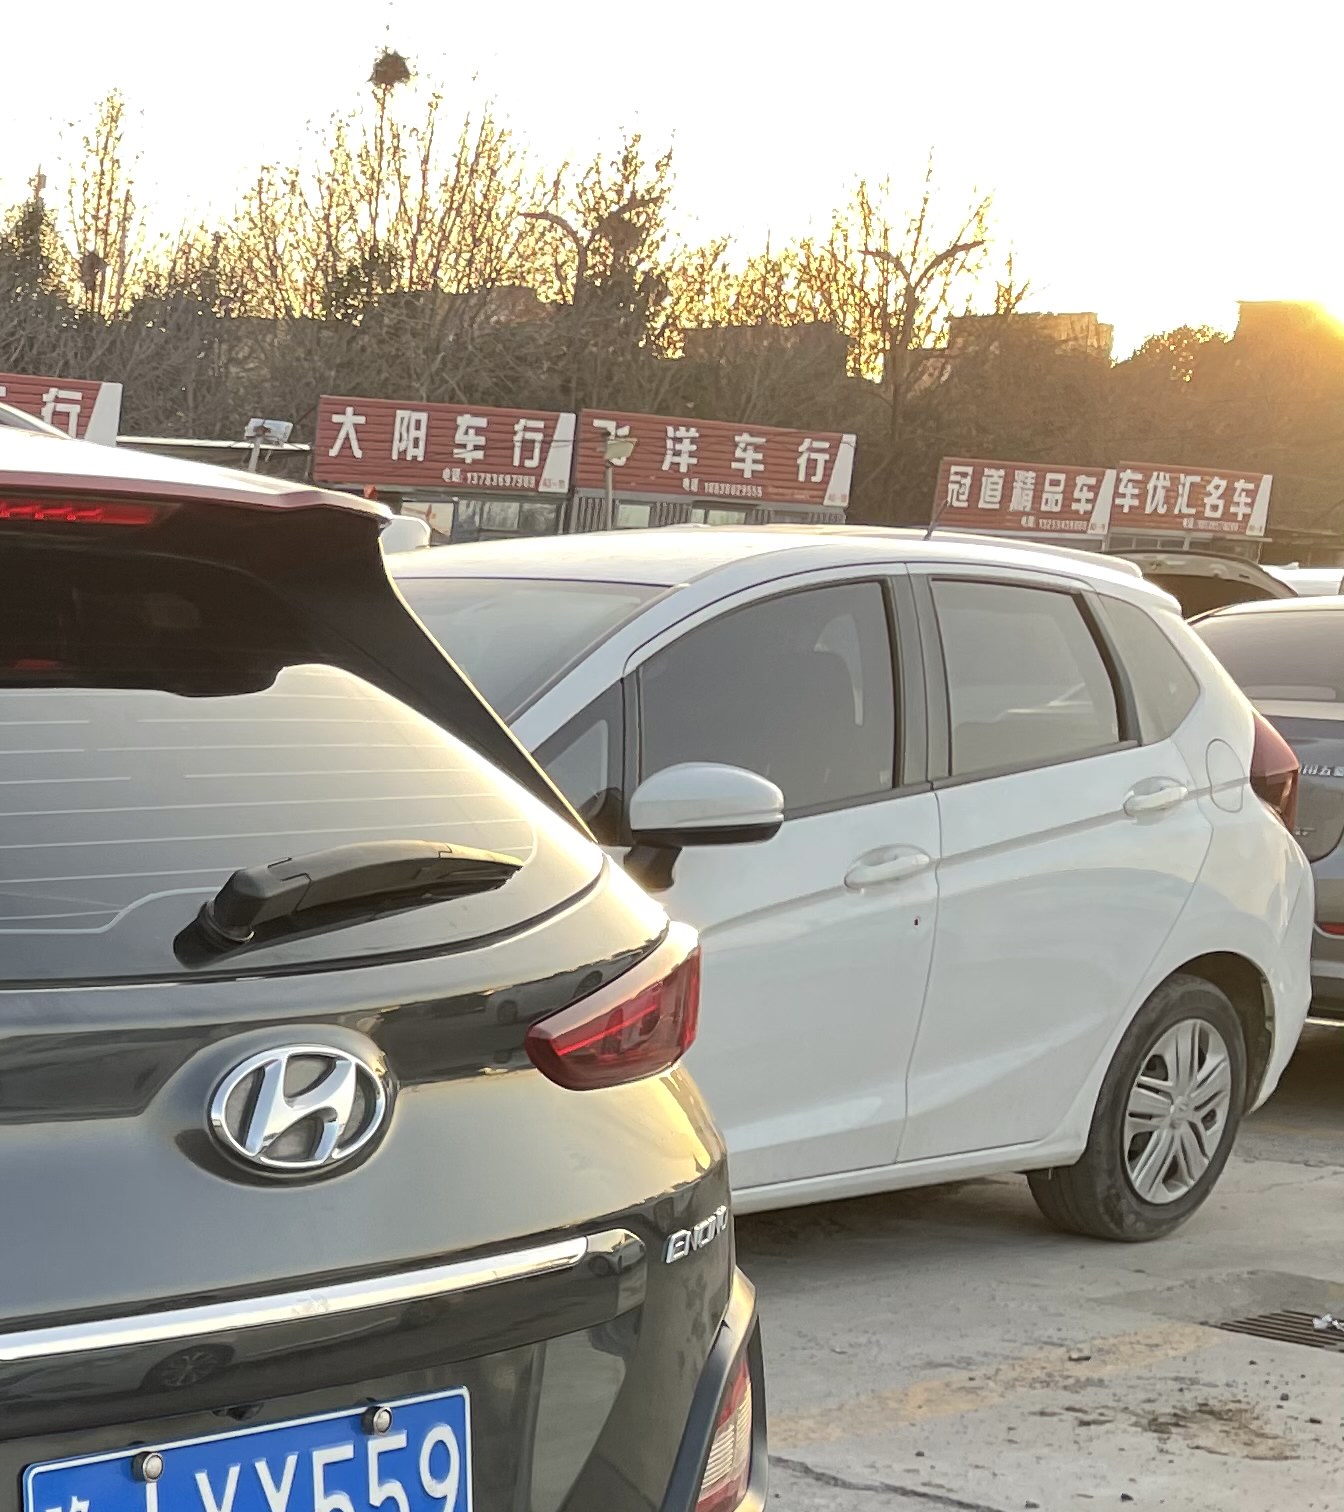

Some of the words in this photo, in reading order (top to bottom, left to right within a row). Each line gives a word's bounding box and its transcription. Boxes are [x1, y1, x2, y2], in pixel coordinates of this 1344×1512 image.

[328, 406, 545, 468] 大阳车行
[946, 465, 1097, 515] 冠道精品车
[1114, 468, 1255, 521] 车优汇名车
